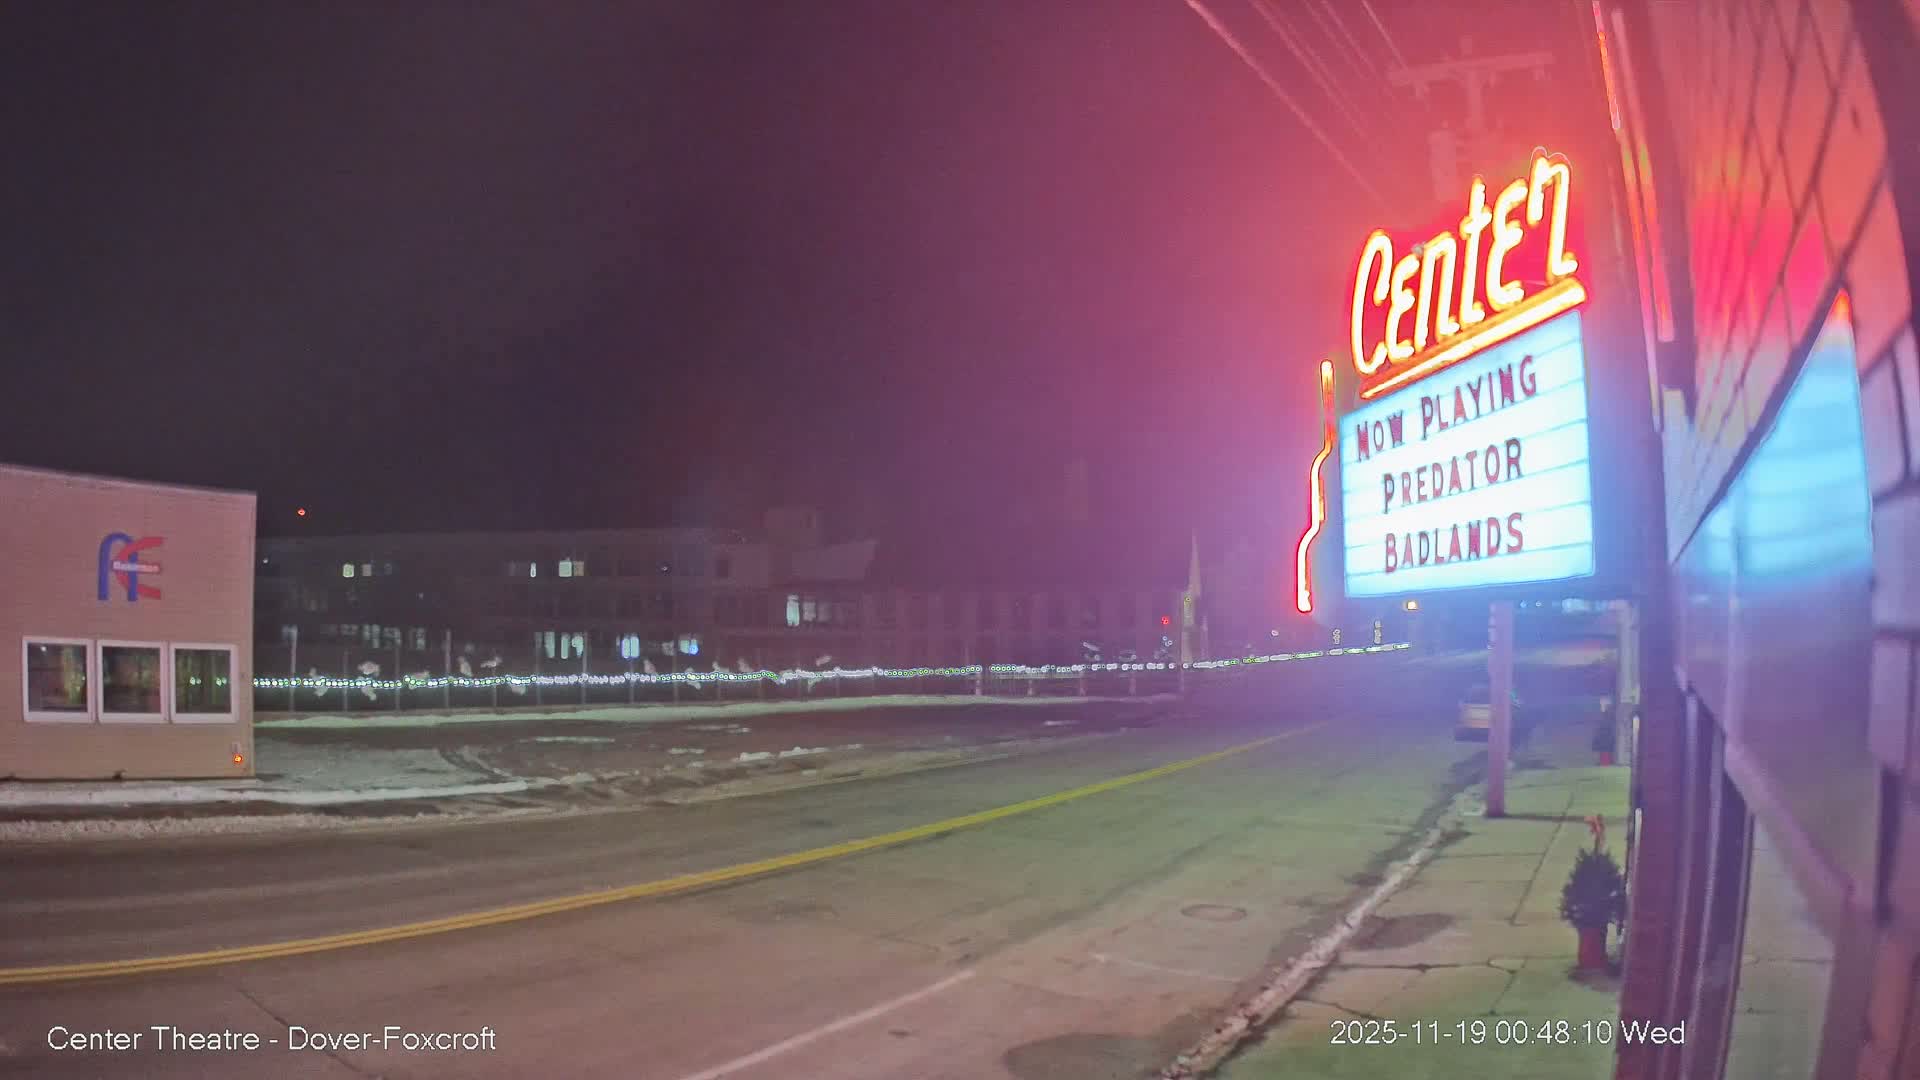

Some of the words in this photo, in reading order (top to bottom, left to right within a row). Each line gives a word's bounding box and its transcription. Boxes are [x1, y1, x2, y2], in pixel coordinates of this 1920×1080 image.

[1351, 149, 1578, 374] Center
[1421, 355, 1537, 441] PLAYING
[1383, 437, 1525, 514] PREDATOR
[1384, 511, 1524, 574] BADLANDS
